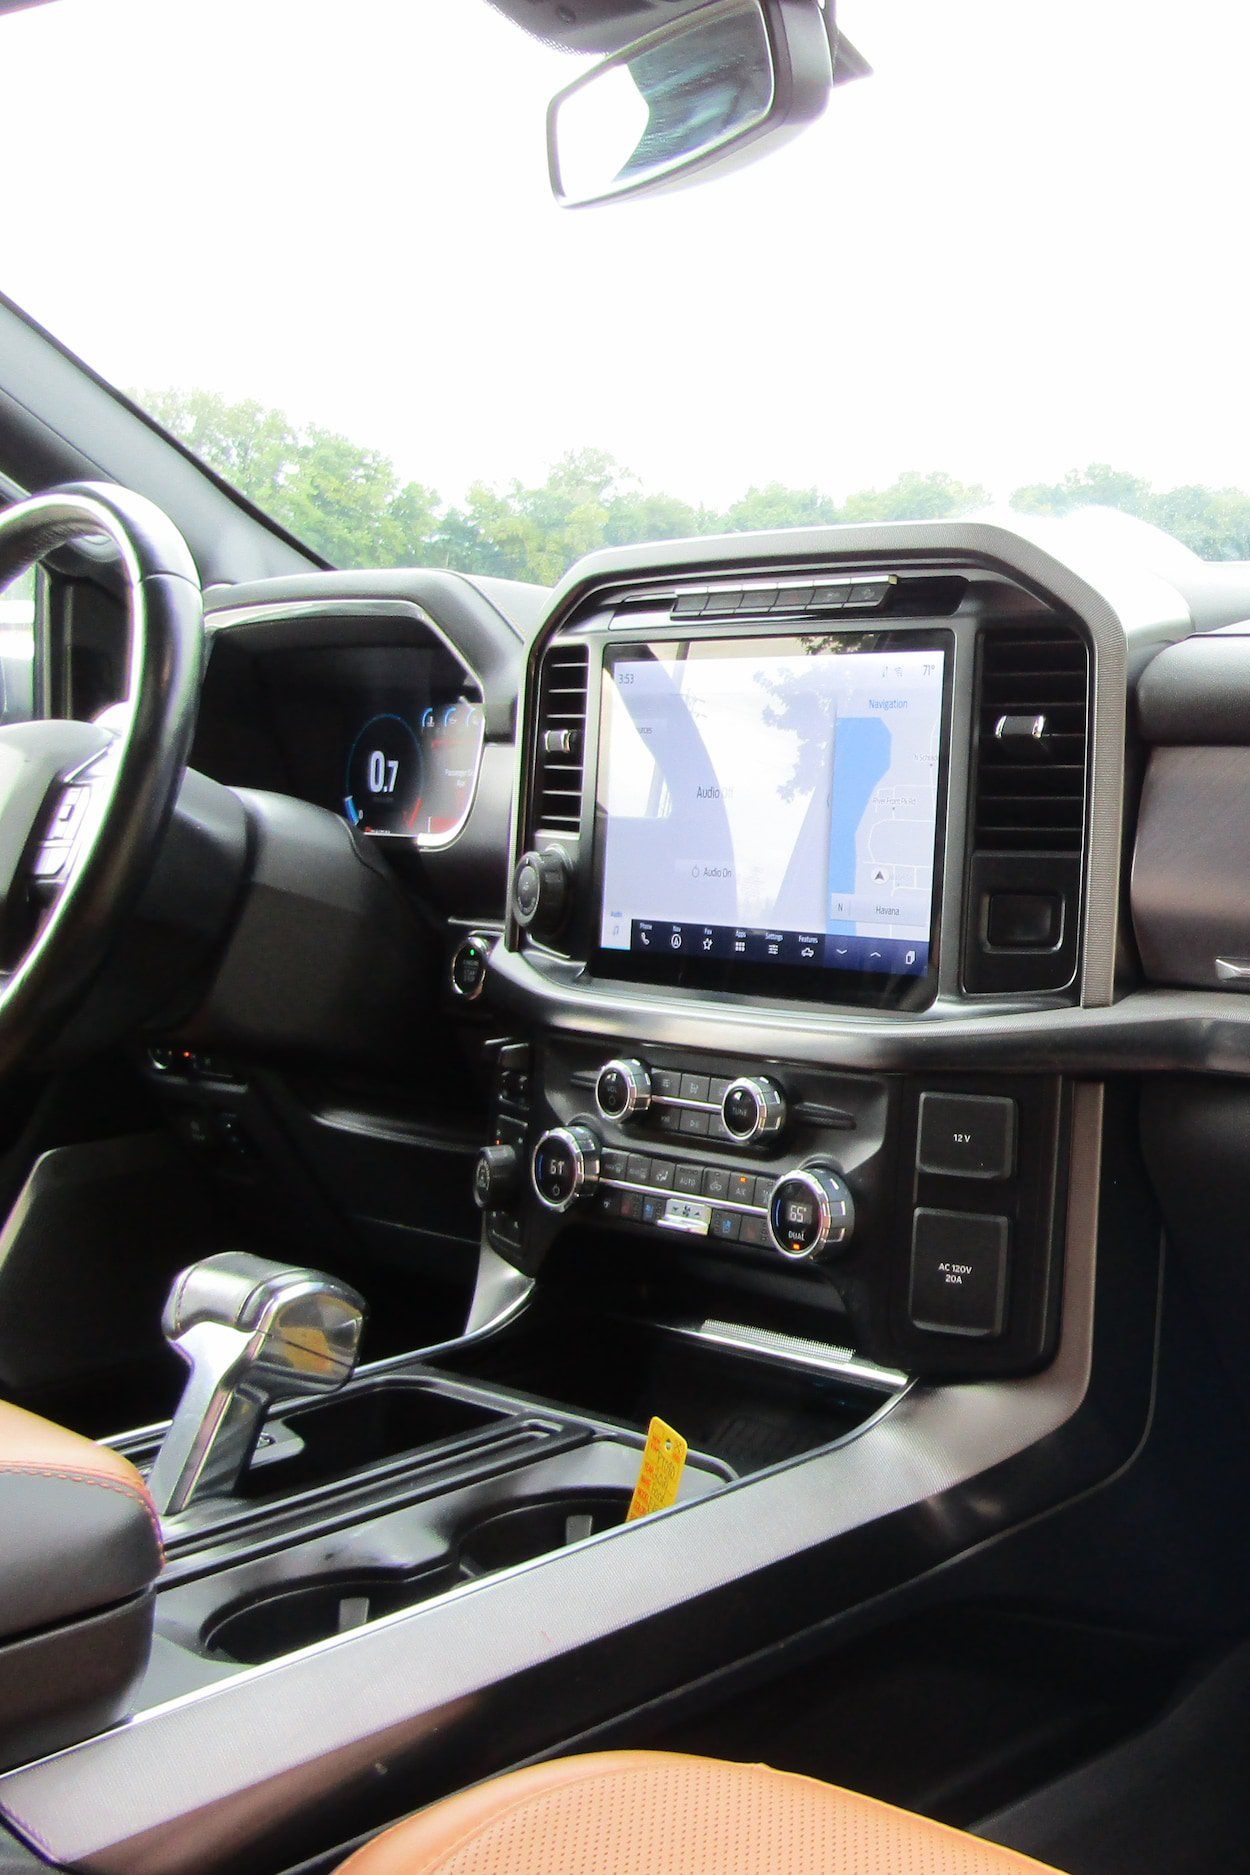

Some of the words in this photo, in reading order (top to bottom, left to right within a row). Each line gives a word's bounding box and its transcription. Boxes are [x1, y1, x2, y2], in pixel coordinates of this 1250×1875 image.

[618, 673, 635, 684] 3:53
[868, 698, 908, 711] Navigation
[369, 750, 399, 793] 0.7
[696, 785, 721, 799] Audio
[703, 867, 722, 878] Audio
[722, 867, 732, 878] On
[875, 905, 900, 916] Havana
[765, 932, 784, 942] Settings
[798, 935, 819, 944] Features
[953, 1133, 963, 1143] 12
[964, 1134, 971, 1143] V
[788, 1230, 805, 1241] DUAL
[938, 1262, 951, 1272] AC
[951, 1263, 973, 1275] 120V
[945, 1273, 963, 1285] 20A
